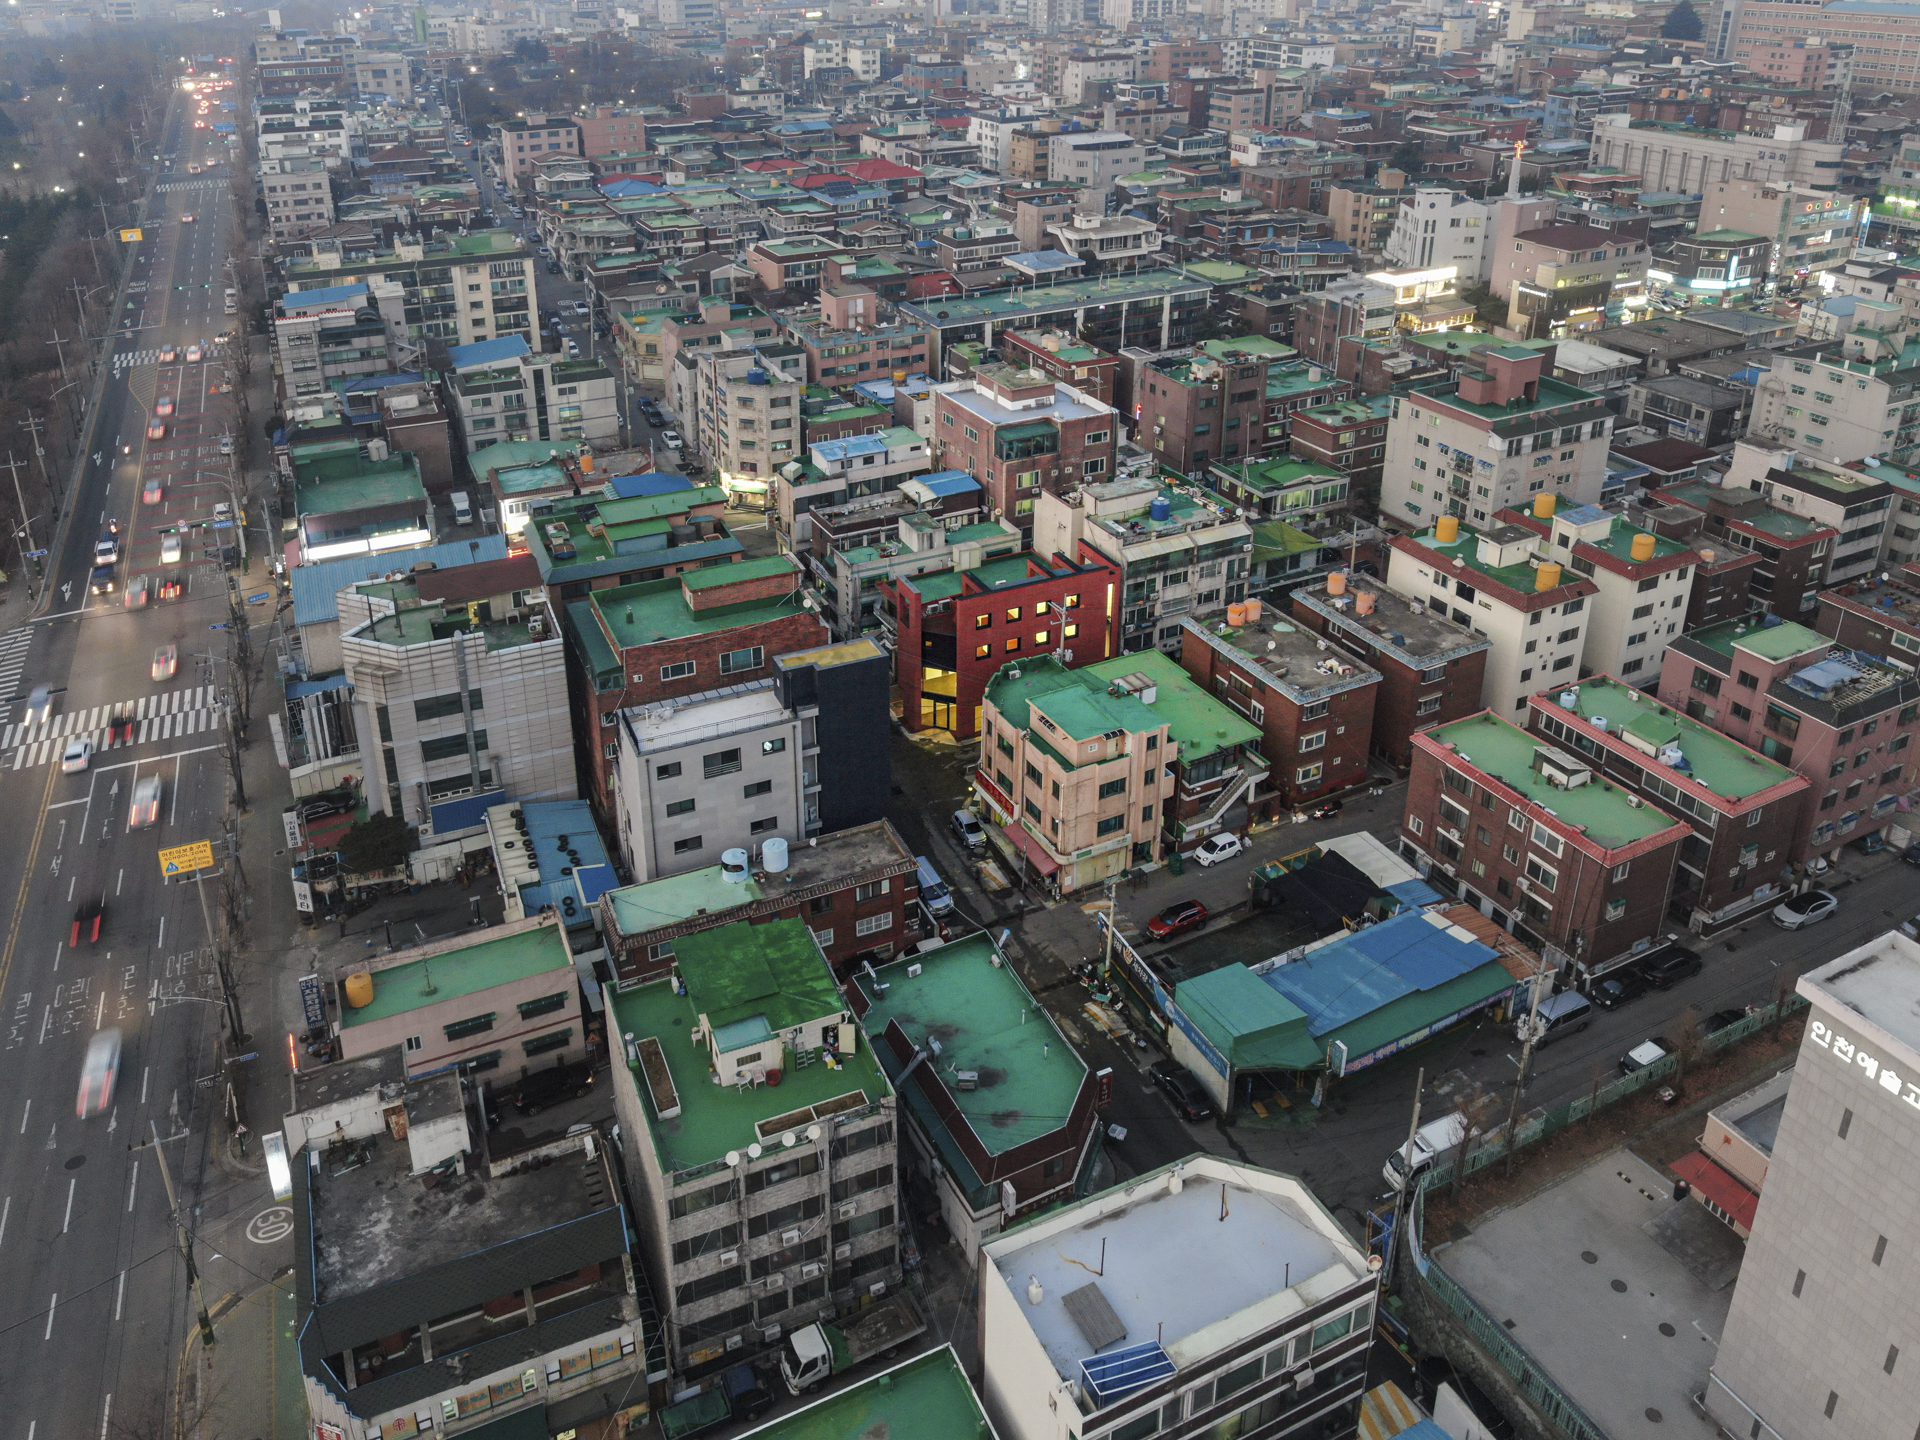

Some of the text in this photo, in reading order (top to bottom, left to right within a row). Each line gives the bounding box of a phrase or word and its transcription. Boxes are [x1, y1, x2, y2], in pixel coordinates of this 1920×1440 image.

[164, 848, 207, 862] SCHOOL ZONE
[256, 1211, 290, 1239] 30
